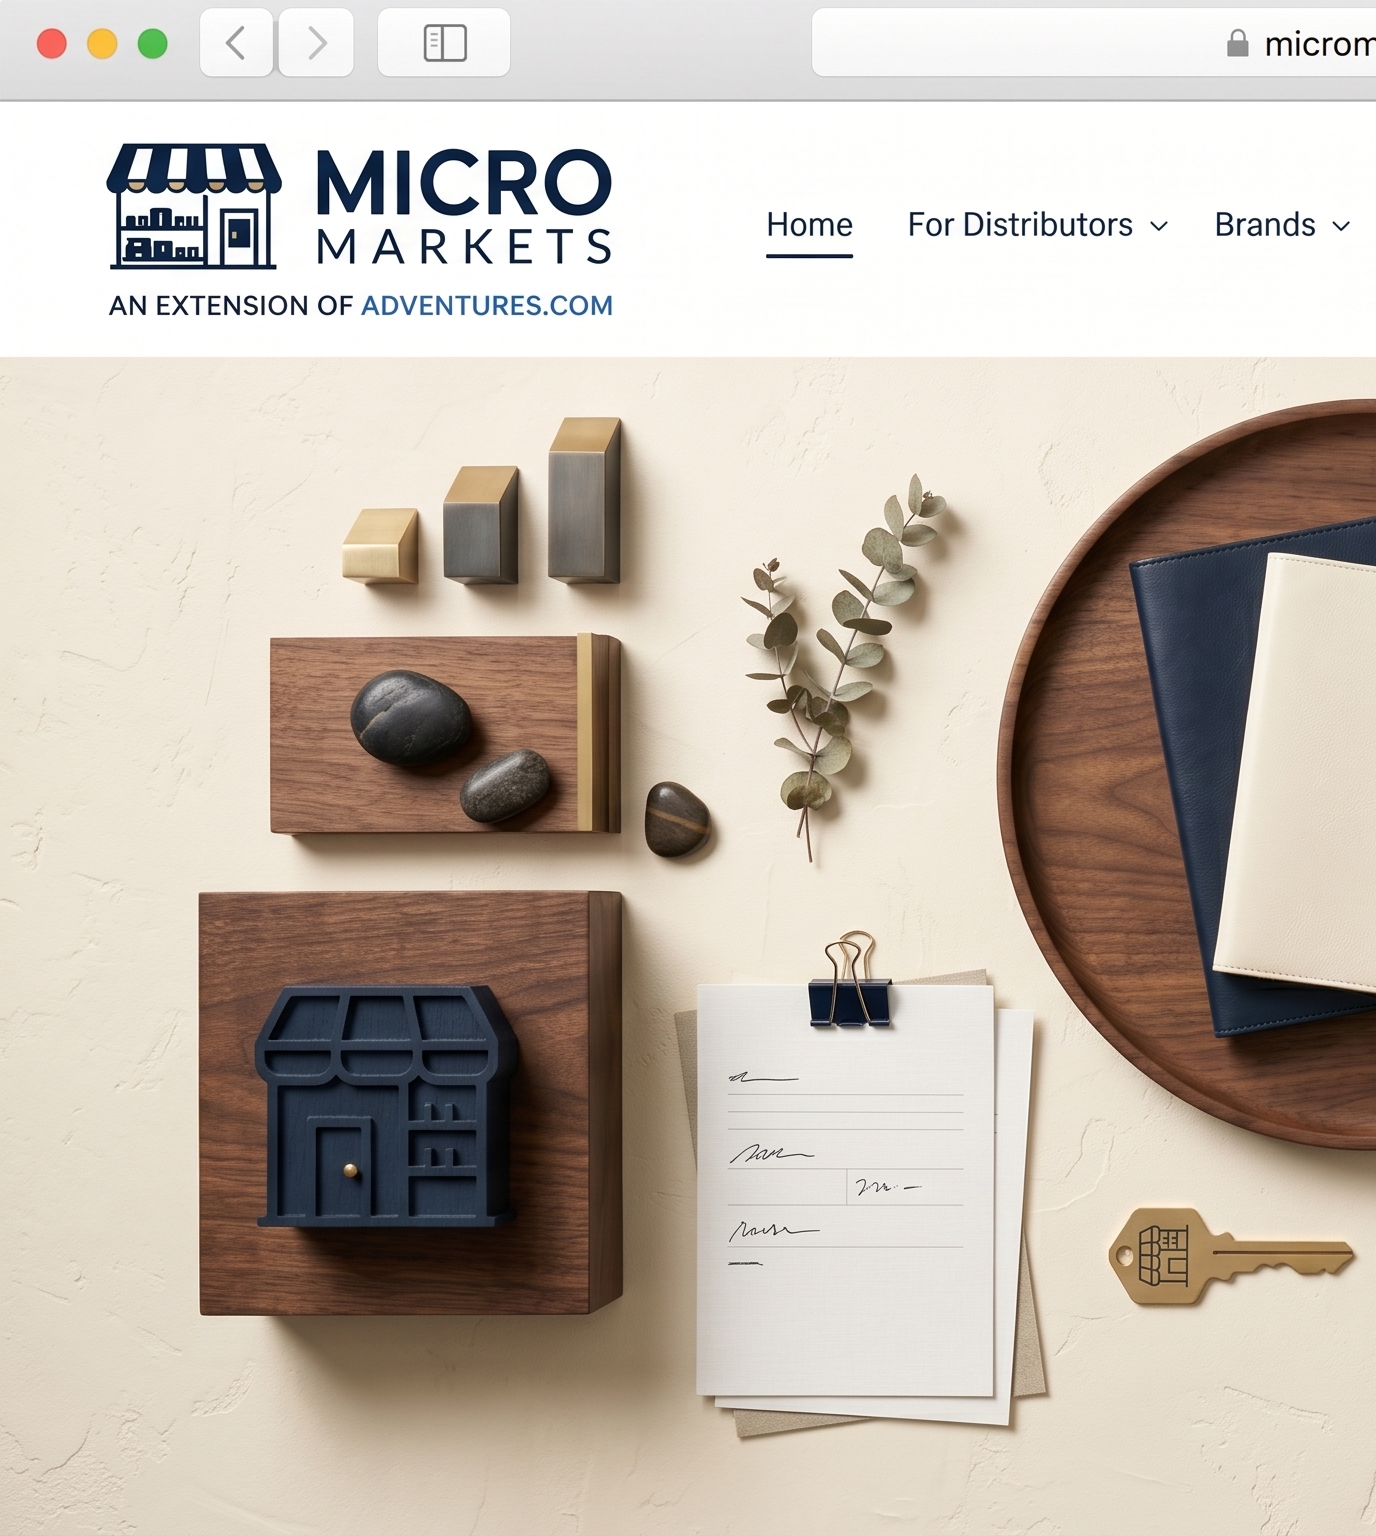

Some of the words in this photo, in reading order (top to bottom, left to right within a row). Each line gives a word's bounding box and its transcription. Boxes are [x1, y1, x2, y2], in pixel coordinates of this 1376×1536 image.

[316, 147, 613, 217] MICRO
[767, 211, 853, 238] Home
[909, 211, 956, 237] For
[964, 210, 1133, 238] Distributors
[1216, 210, 1316, 238] Brands
[317, 228, 612, 265] MARKETS
[108, 294, 147, 316] AN
[156, 294, 308, 317] EXTENSION
[317, 294, 354, 317] OF
[360, 294, 613, 317] ADVENTURES.COM
